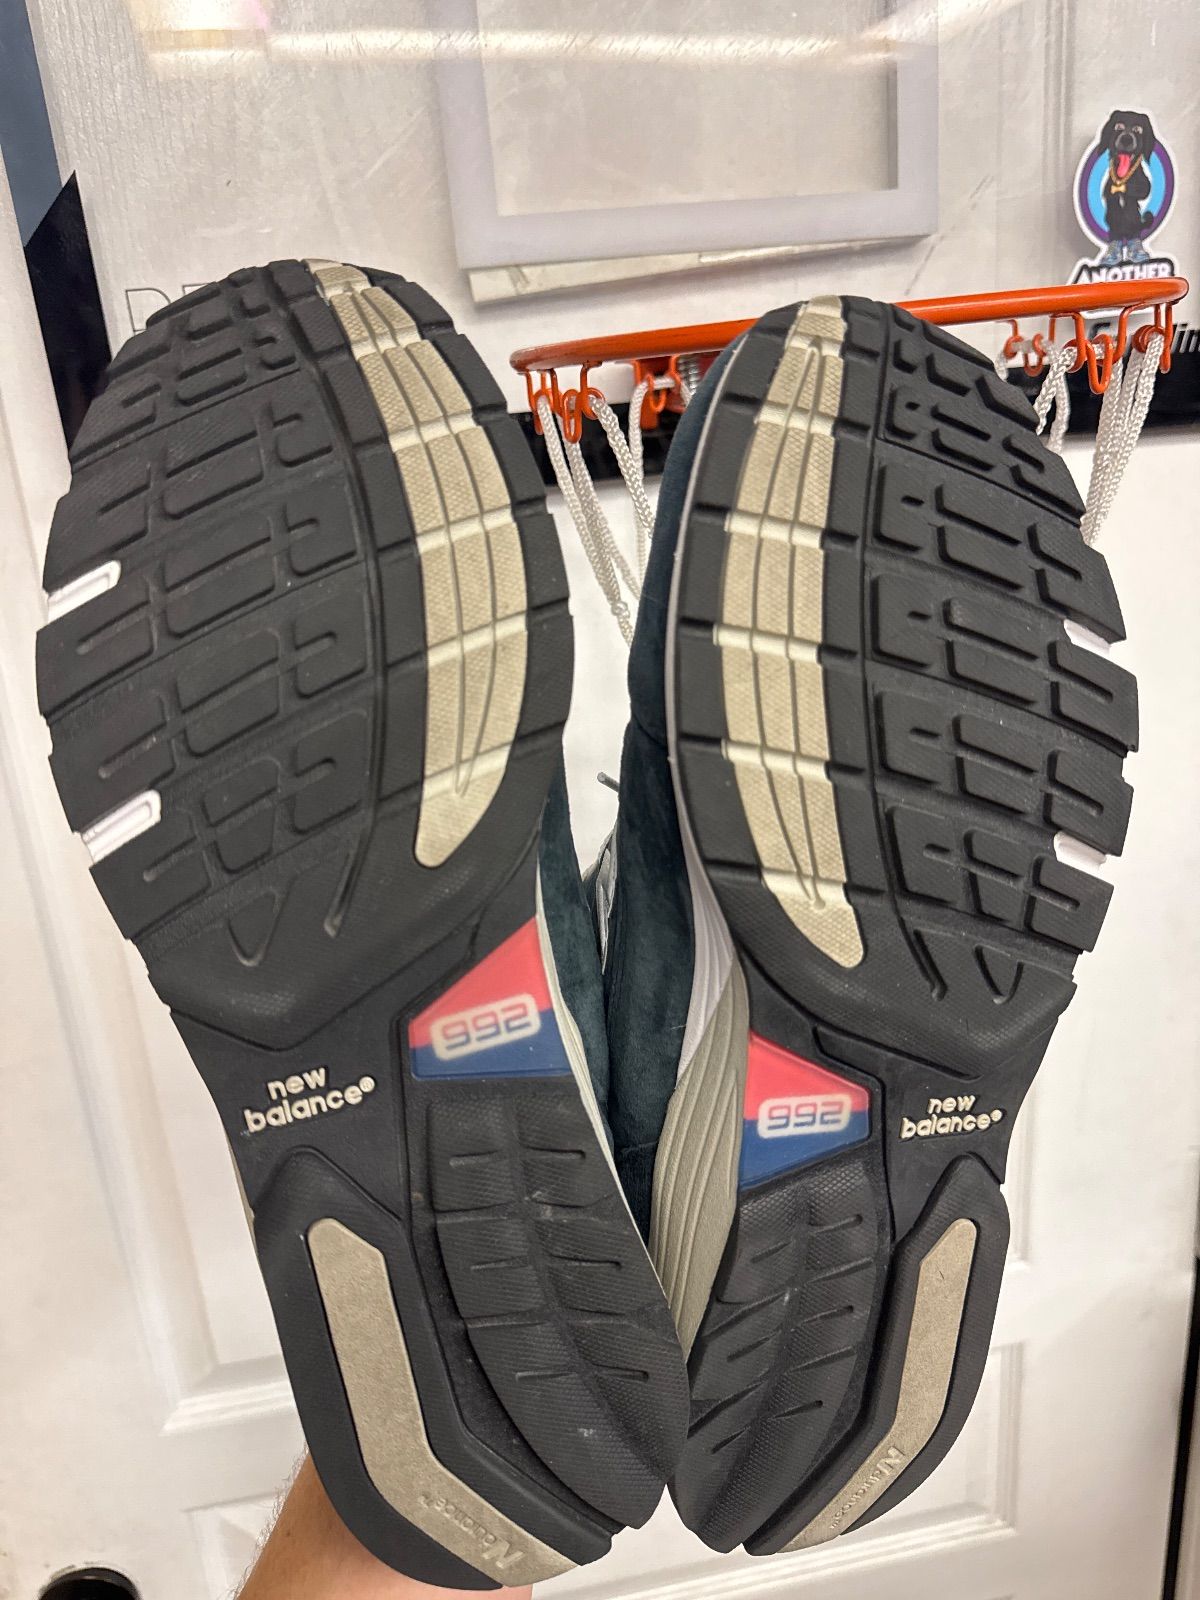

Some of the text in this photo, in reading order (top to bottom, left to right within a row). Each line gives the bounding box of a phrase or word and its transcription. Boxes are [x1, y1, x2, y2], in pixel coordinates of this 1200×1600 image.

[1077, 262, 1171, 284] ANOTHER
[441, 1003, 532, 1050] 992
[266, 1067, 326, 1100] new
[767, 1101, 845, 1131] 992
[928, 1095, 976, 1115] new
